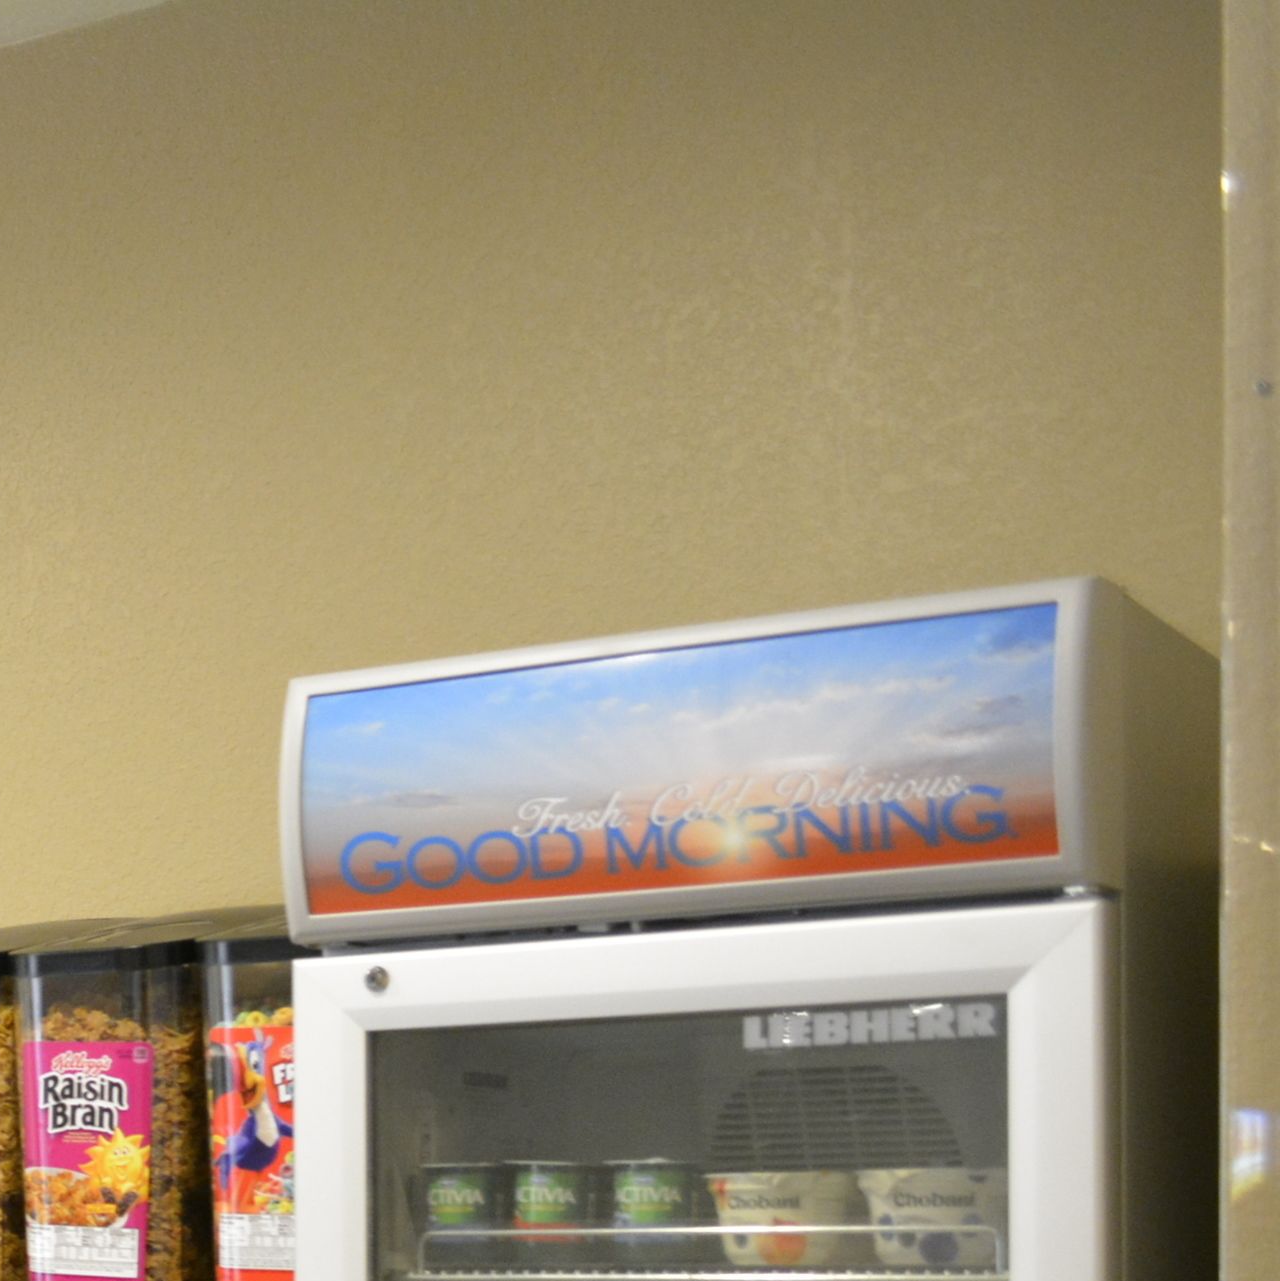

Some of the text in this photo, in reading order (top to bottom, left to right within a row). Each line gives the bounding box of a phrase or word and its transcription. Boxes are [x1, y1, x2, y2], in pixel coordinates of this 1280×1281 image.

[339, 826, 584, 894] GOOD
[742, 1002, 997, 1049] LIEBHERR
[51, 1051, 113, 1077] Kellogg's
[41, 1074, 127, 1108] Raisin
[50, 1102, 116, 1132] Bran
[727, 1194, 800, 1211] Chobani
[892, 1191, 976, 1209] Chobani
